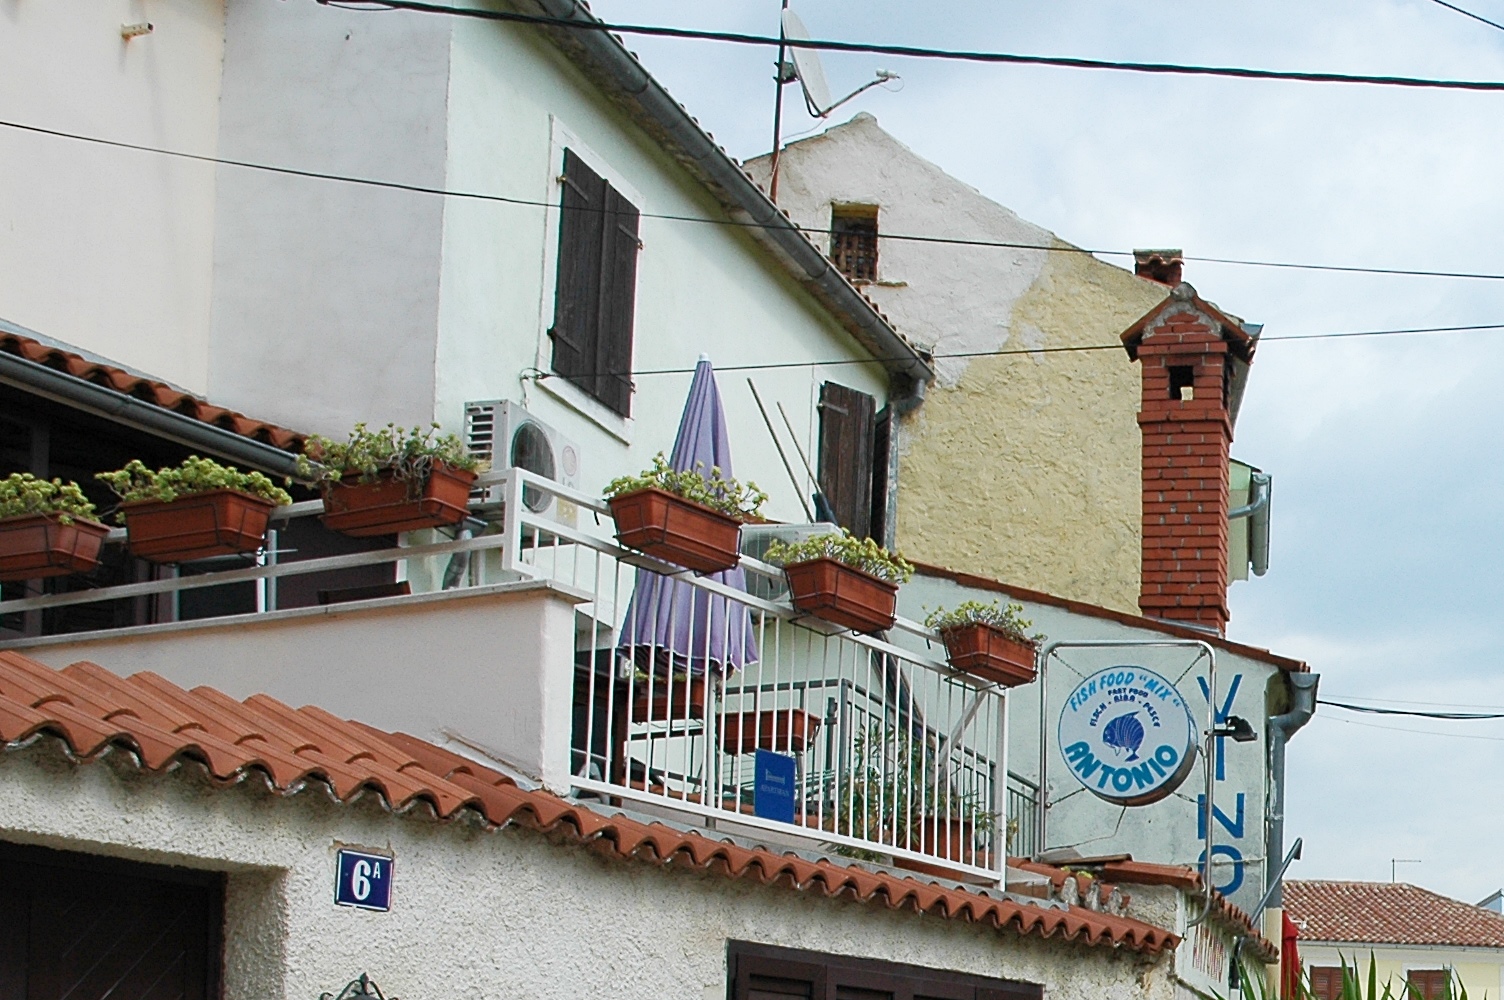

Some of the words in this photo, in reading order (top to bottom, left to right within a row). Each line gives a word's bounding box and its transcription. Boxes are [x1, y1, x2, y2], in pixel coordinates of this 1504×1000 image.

[1069, 680, 1097, 712] FISH
[1100, 672, 1135, 690] FOOD
[1064, 741, 1178, 792] ANTONIO
